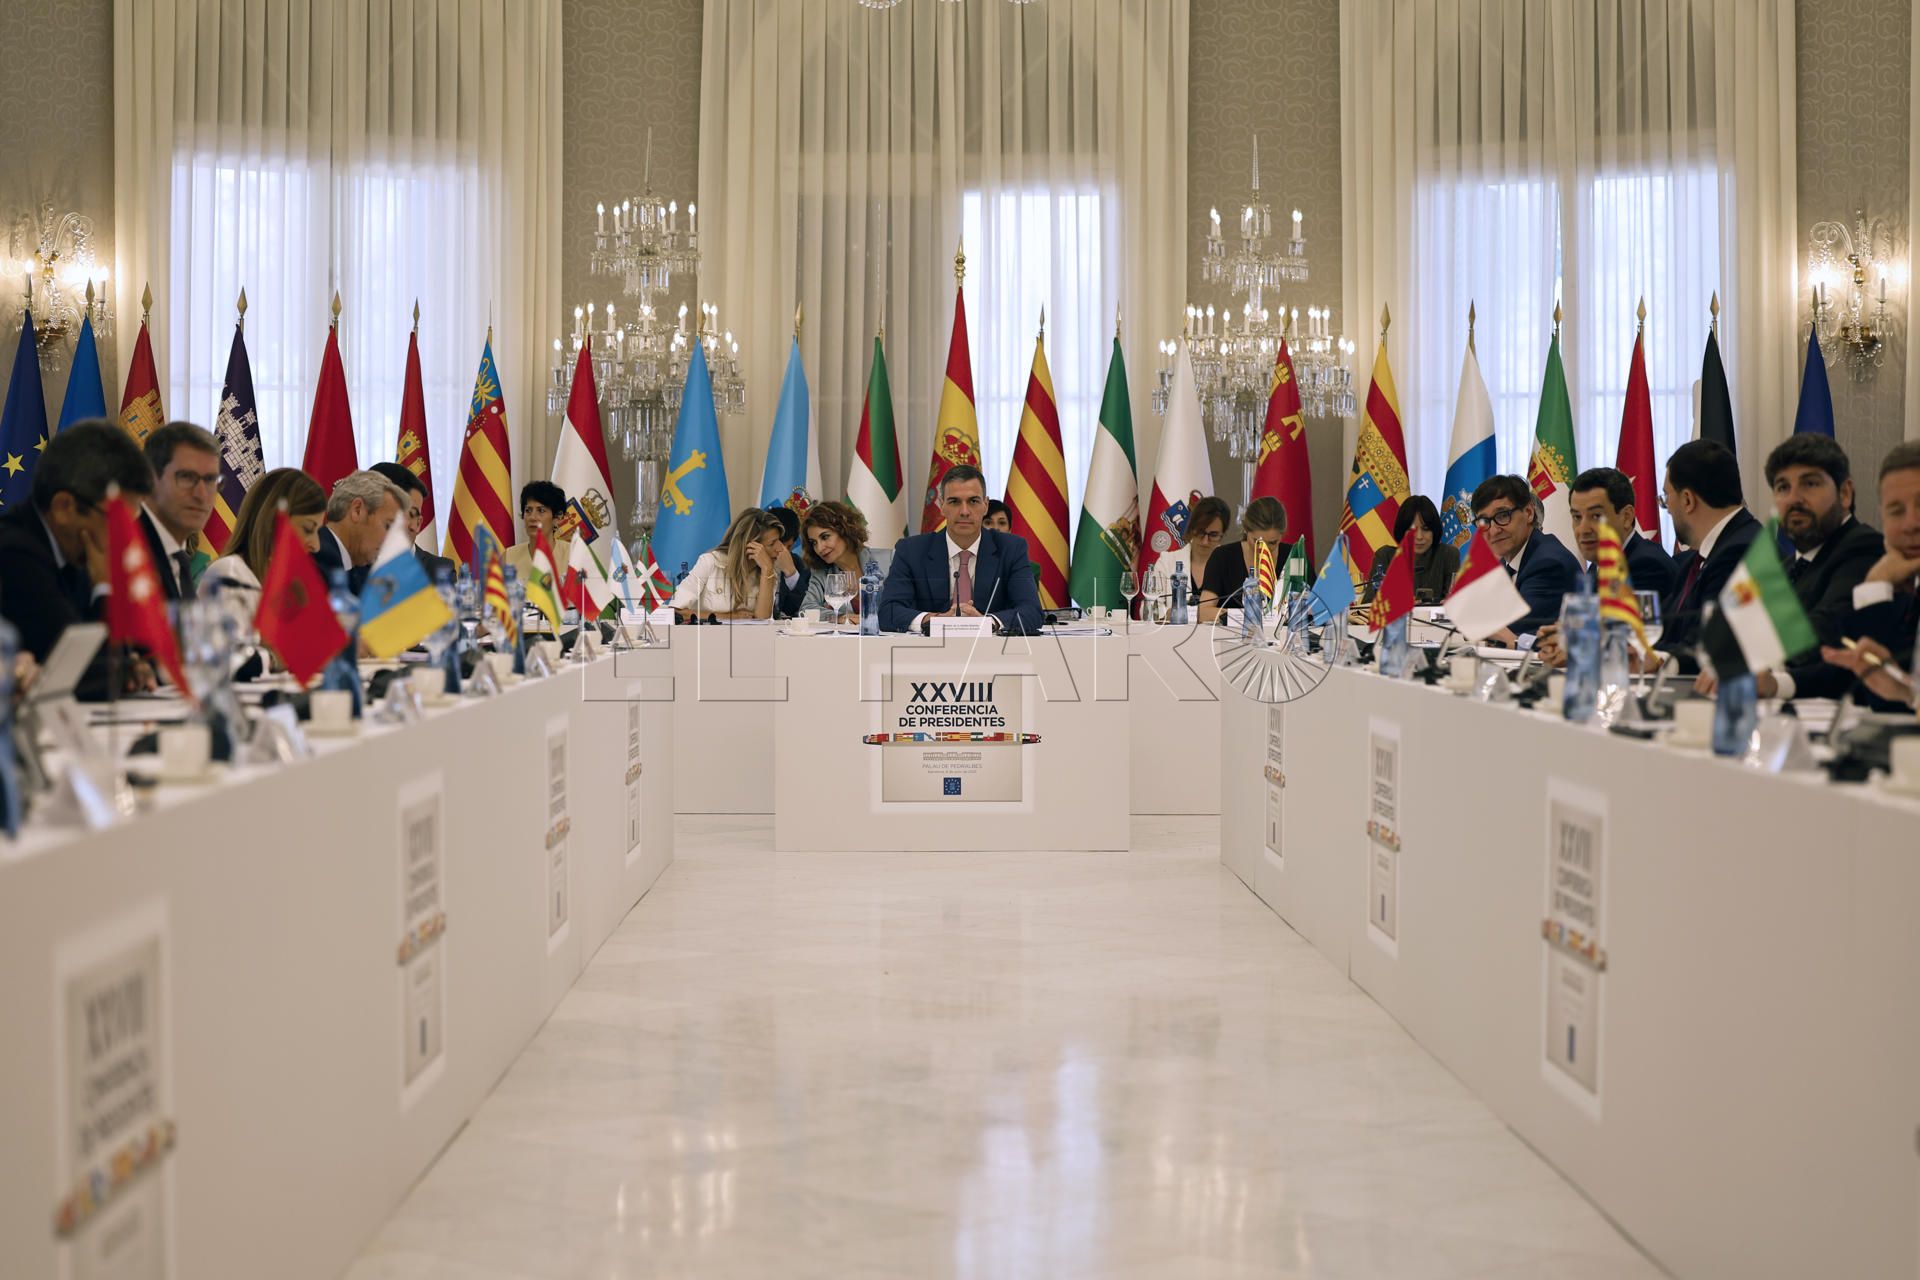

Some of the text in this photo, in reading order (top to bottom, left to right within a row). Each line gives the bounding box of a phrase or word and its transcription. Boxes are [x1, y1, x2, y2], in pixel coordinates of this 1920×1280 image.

[910, 682, 993, 702] XXVIII
[905, 704, 998, 715] CONFERENCIA
[899, 717, 1006, 727] DE PRESIDENTES
